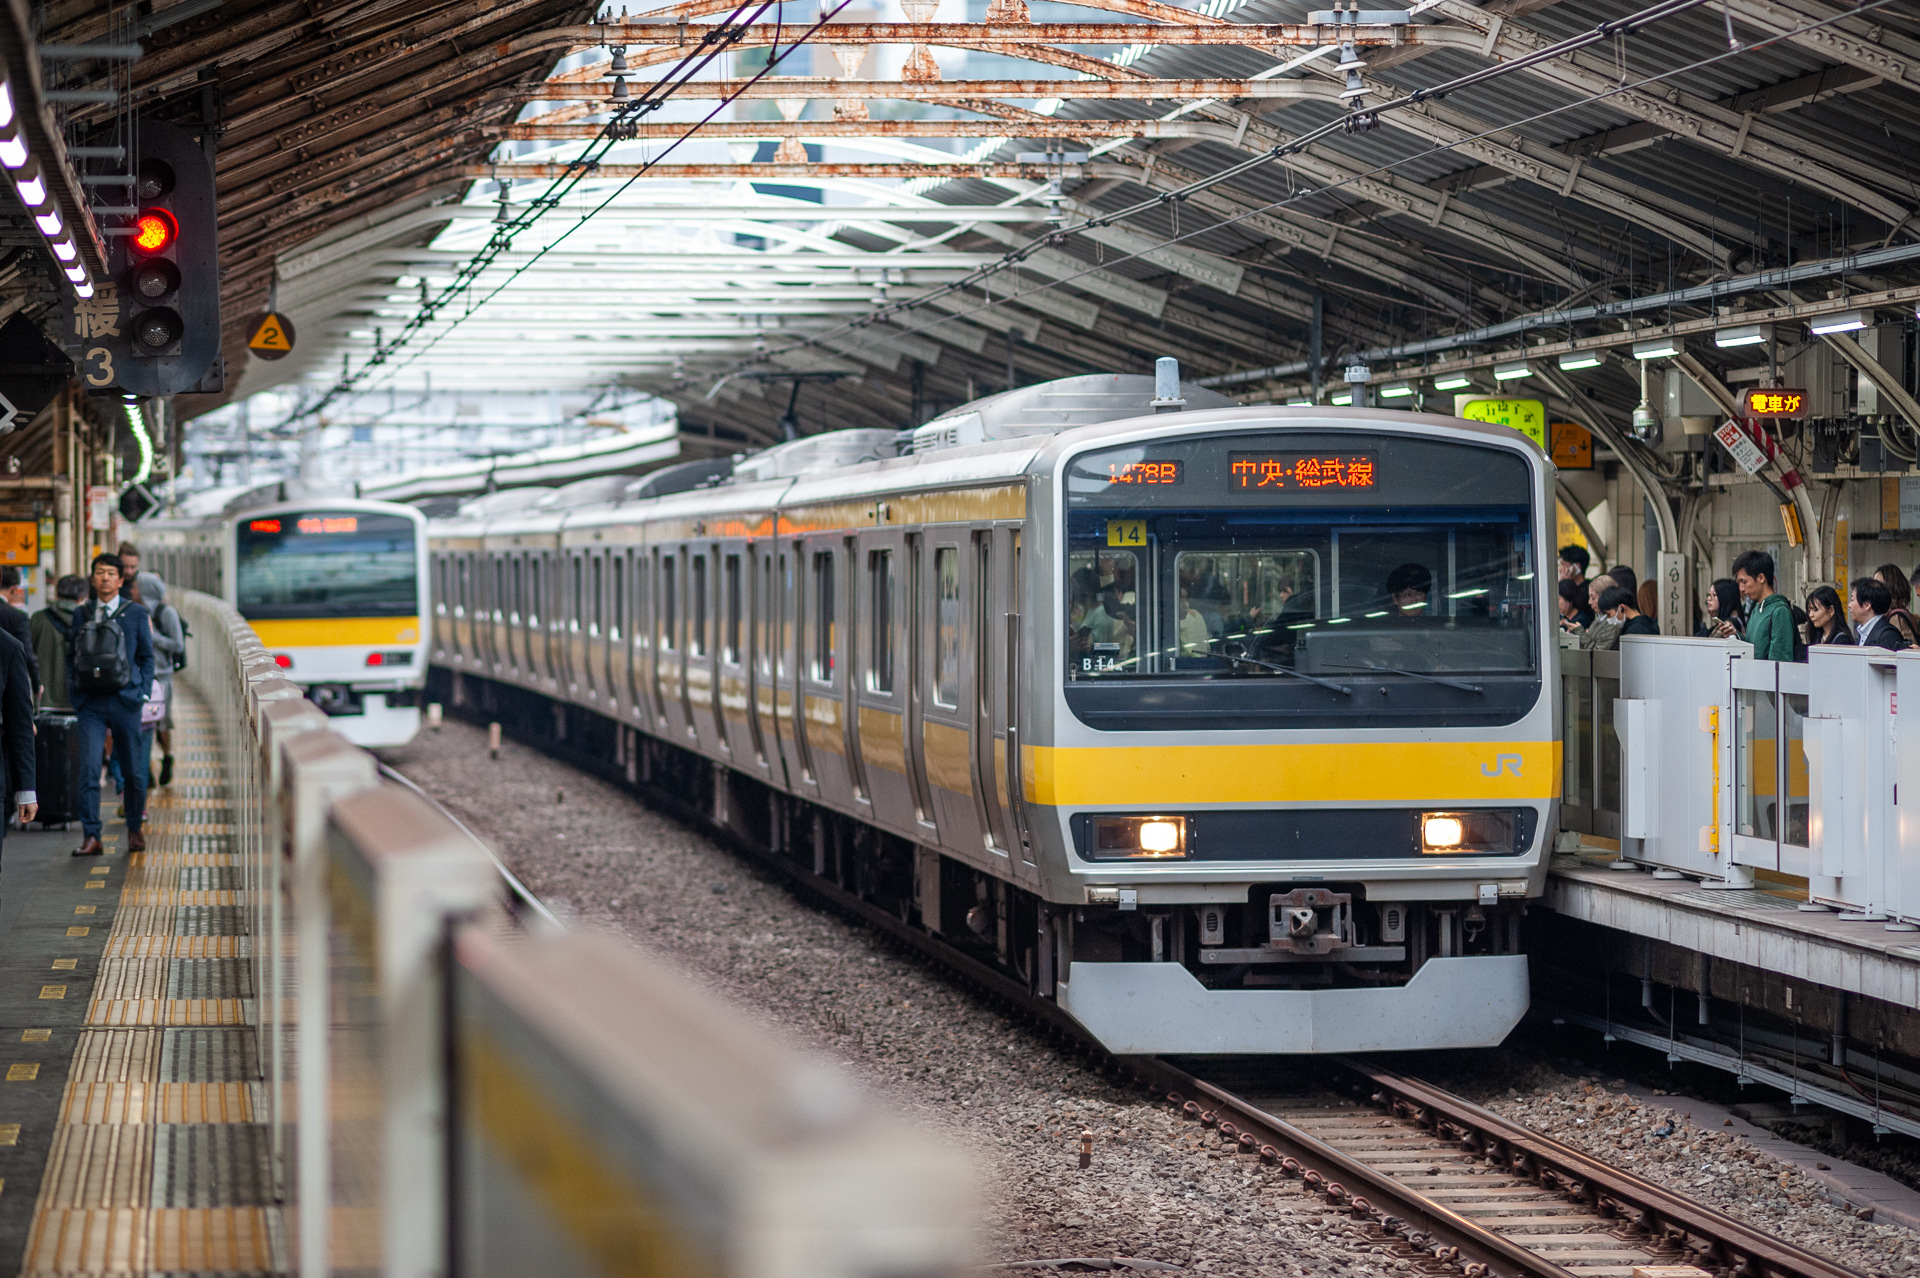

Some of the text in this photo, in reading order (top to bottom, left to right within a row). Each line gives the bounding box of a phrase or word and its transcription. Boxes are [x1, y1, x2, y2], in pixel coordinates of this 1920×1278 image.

[73, 281, 120, 339] 緩
[263, 327, 278, 345] 2
[86, 347, 115, 387] 3
[1750, 393, 1802, 414] 電車が
[1231, 457, 1374, 488] 中央・総武線
[1115, 525, 1141, 544] 14
[1480, 752, 1524, 778] JR
